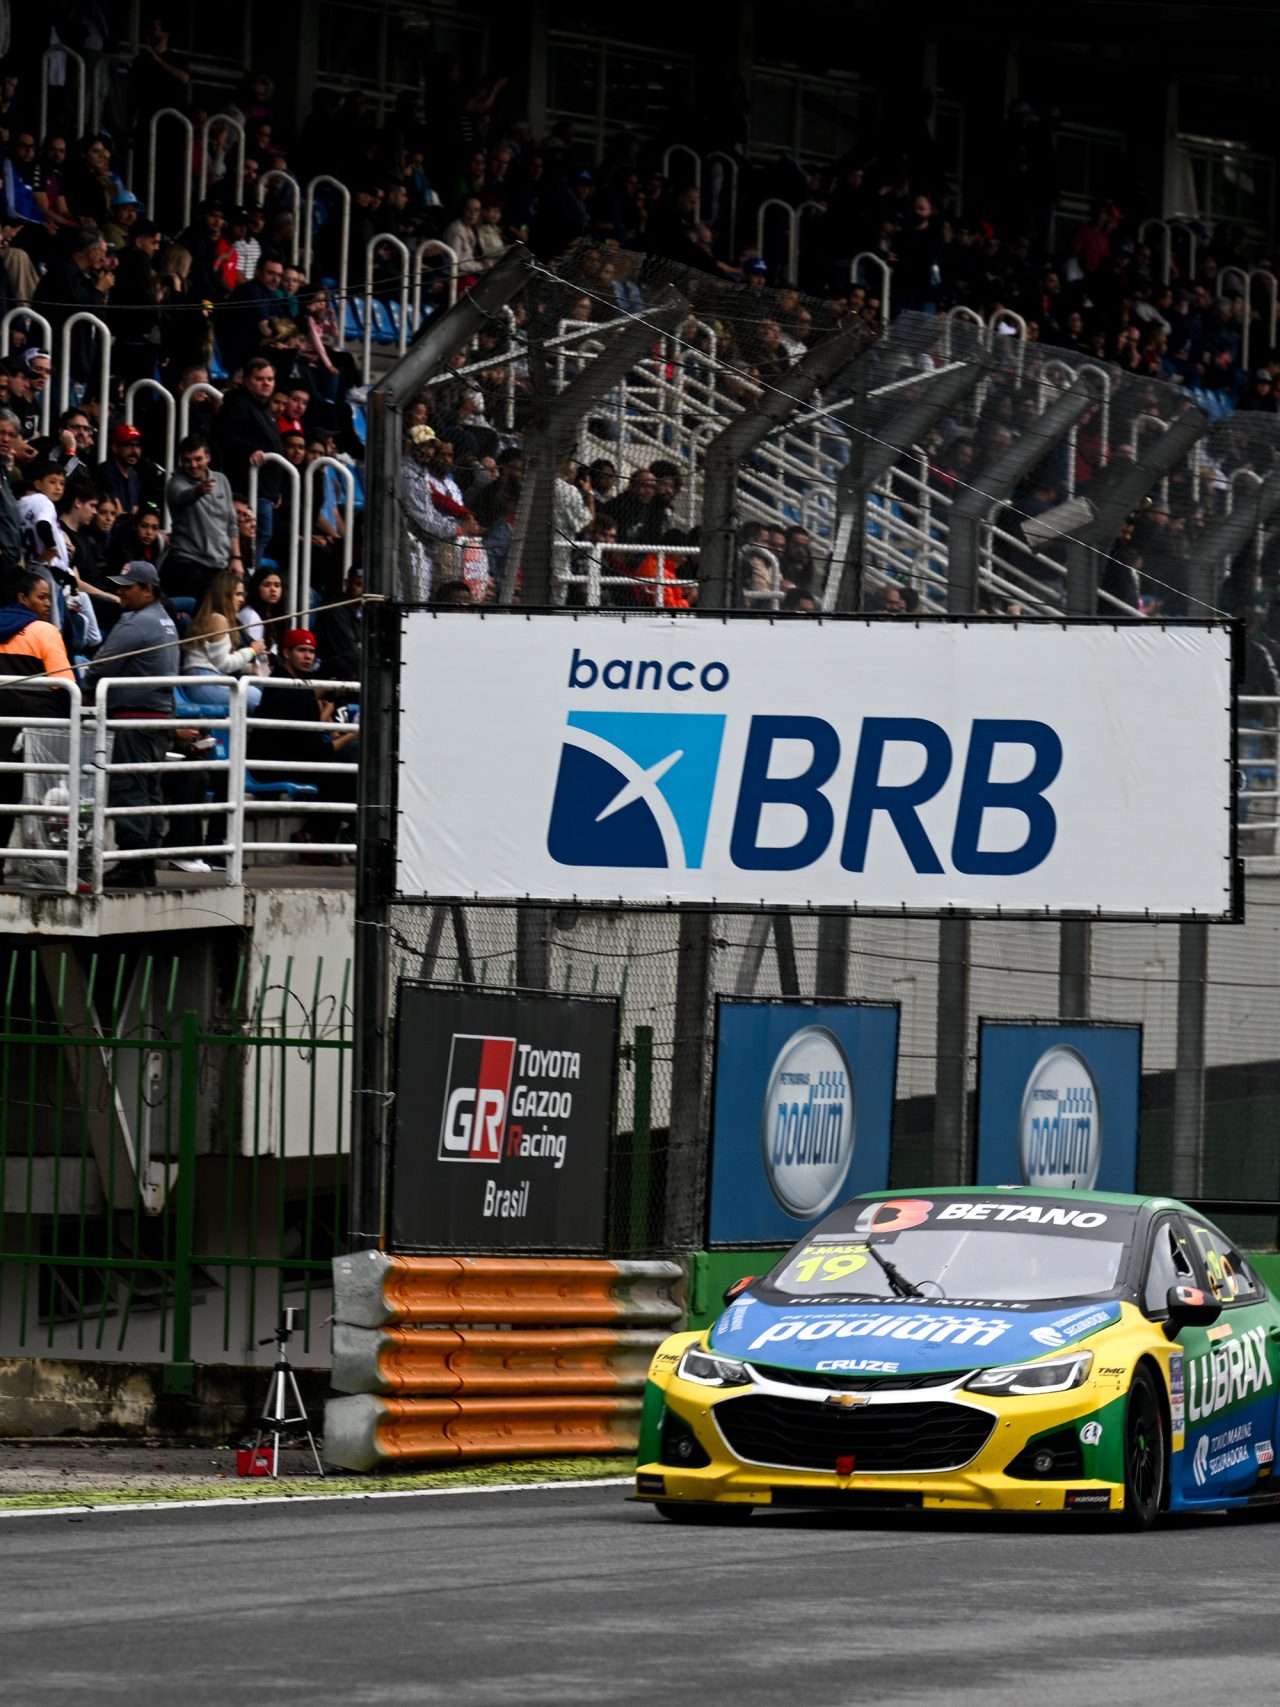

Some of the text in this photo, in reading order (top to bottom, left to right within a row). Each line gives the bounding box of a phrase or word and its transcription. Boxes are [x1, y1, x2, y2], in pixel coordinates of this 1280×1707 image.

[567, 648, 730, 692] banco
[729, 714, 1063, 876] BRB
[518, 1044, 581, 1079] TOYOTA
[444, 1087, 505, 1152] GR
[773, 1084, 844, 1167] podium
[1029, 1100, 1091, 1177] podium
[507, 1125, 567, 1169] Racing
[483, 1179, 530, 1218] Brasil
[936, 1202, 1108, 1229] BETANO
[796, 1254, 868, 1282] 19
[748, 1315, 1009, 1351] podium
[815, 1360, 900, 1373] CRUZE
[1188, 1325, 1273, 1422] LUBRAX
